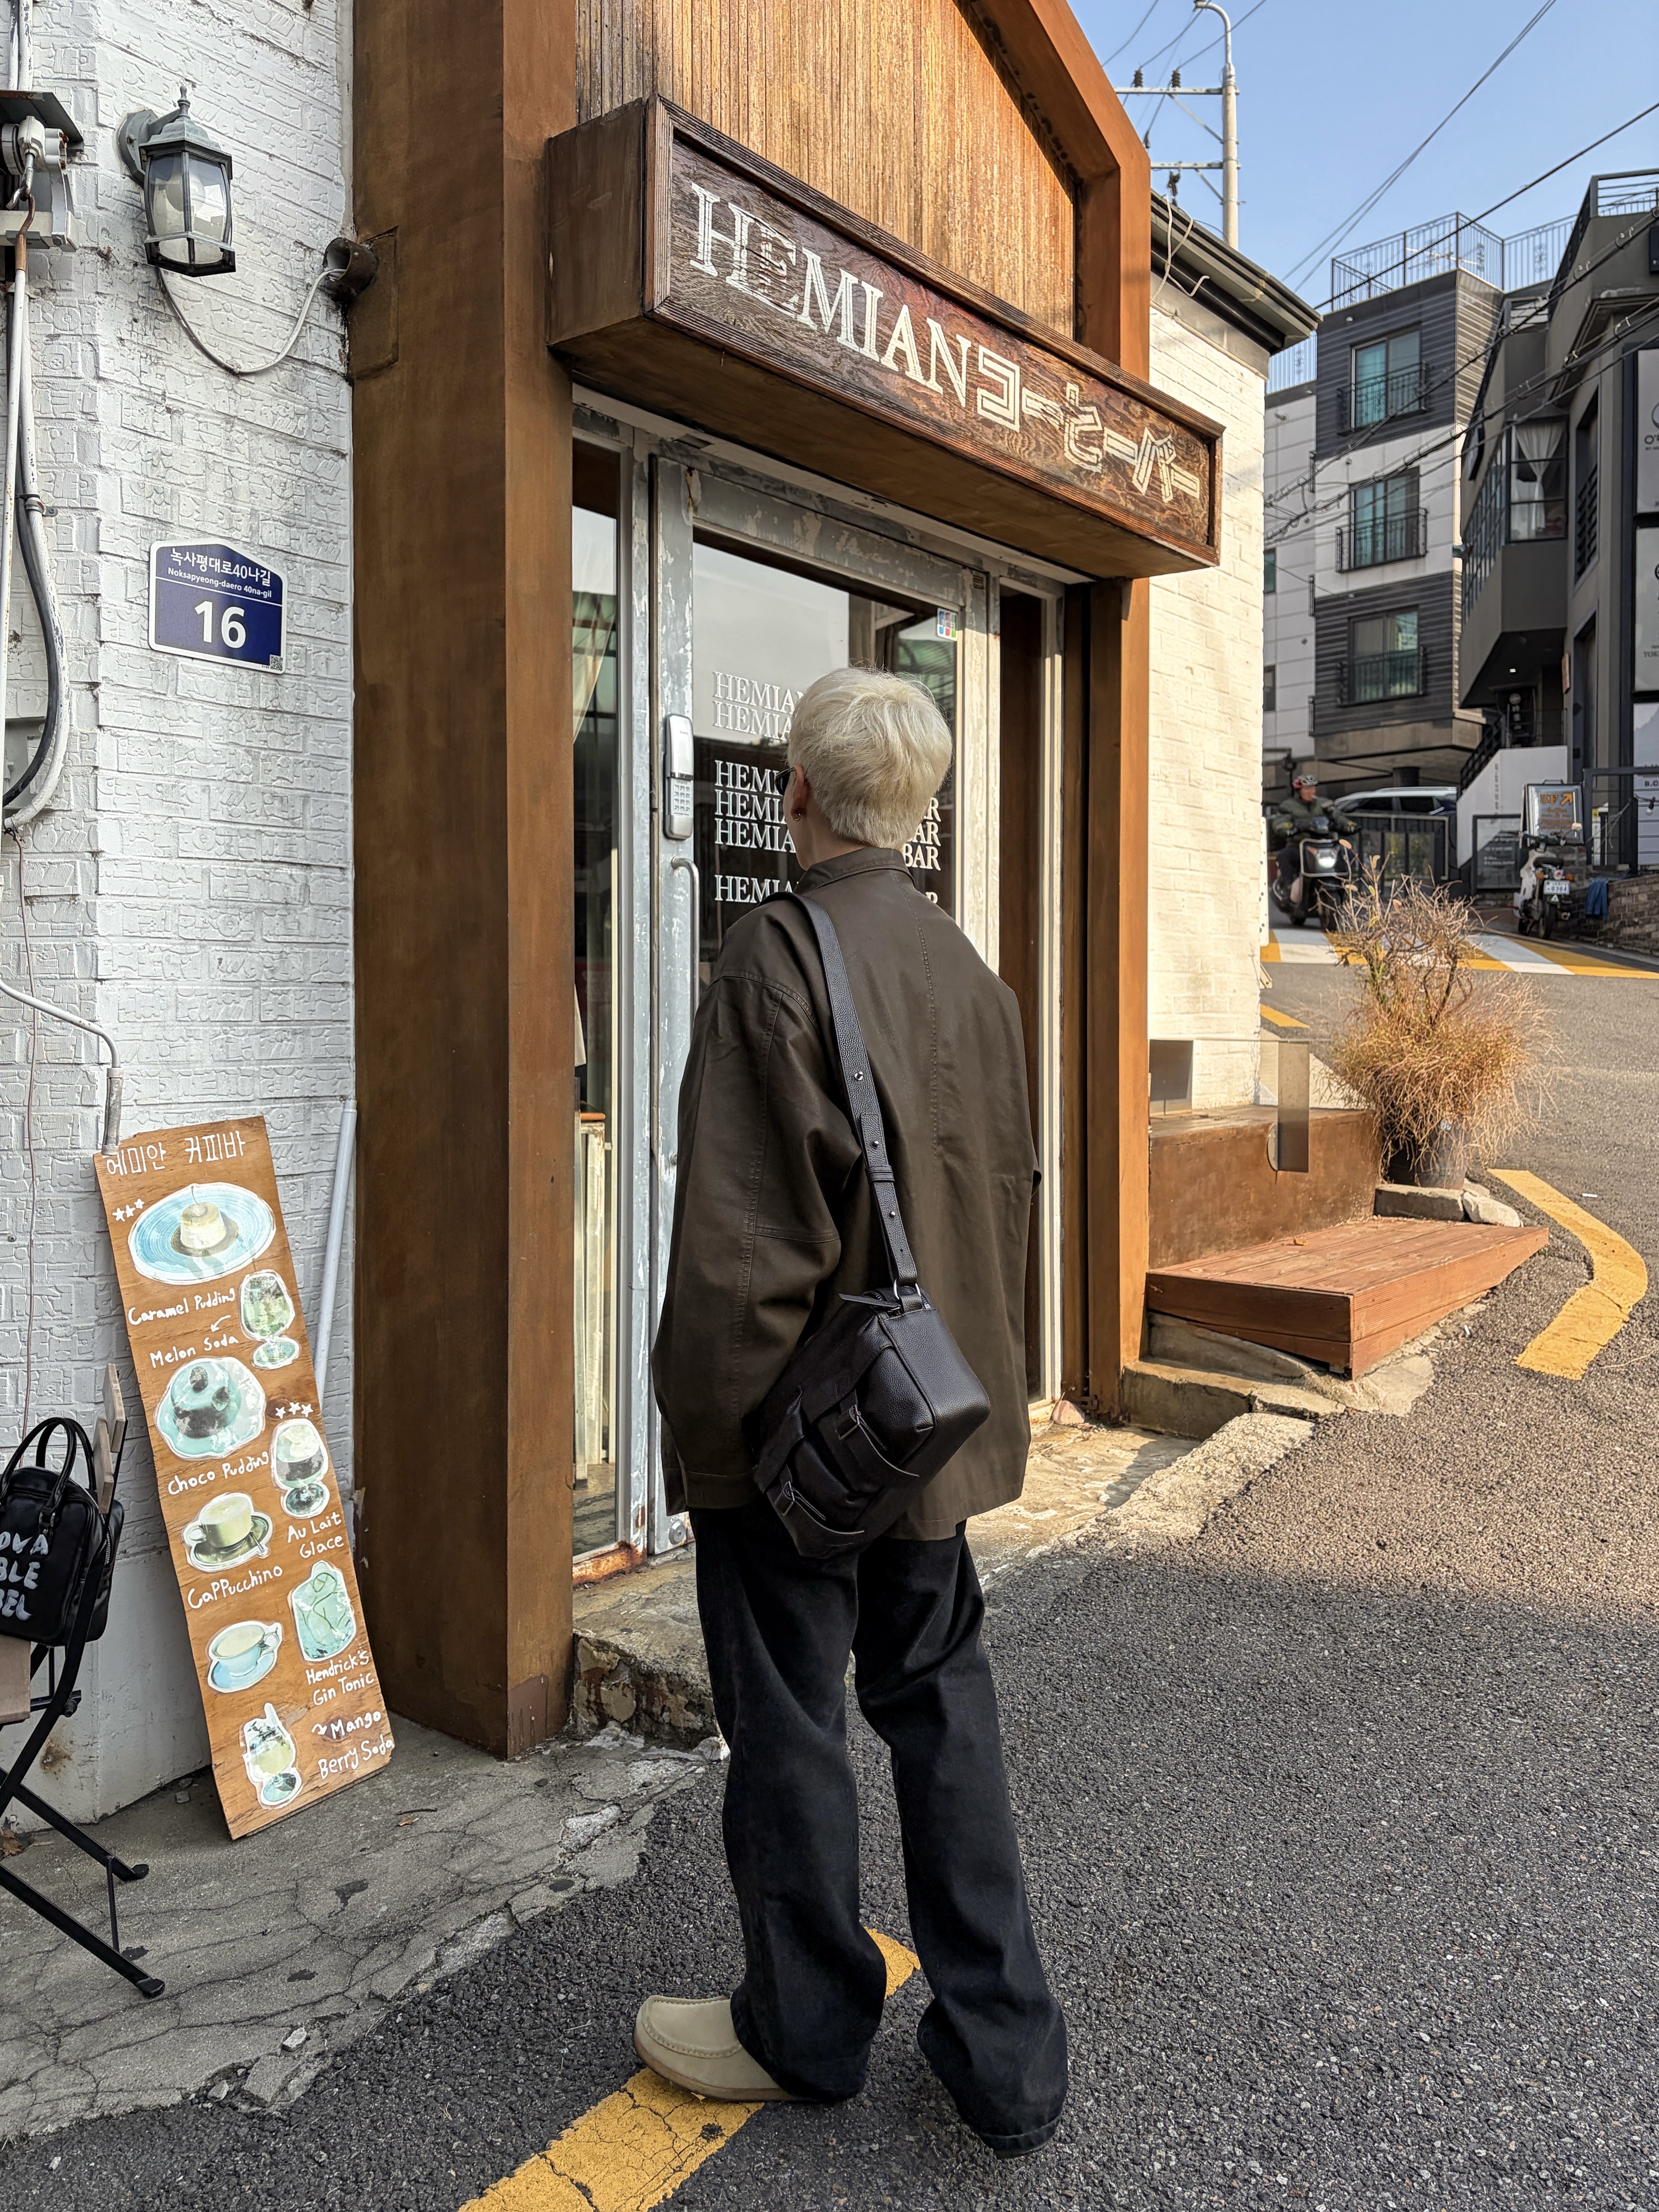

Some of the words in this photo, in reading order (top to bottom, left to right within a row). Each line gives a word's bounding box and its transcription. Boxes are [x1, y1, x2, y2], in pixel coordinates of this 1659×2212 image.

[168, 567, 242, 591] Noksapyeong-daero
[244, 586, 272, 598] 40na-gil
[170, 548, 271, 587] 녹사평대로40나길
[195, 601, 246, 648] 16
[712, 671, 804, 715] HEMIA
[712, 700, 791, 740] HEMIA
[714, 789, 787, 824] HEMI
[714, 818, 796, 853] HEMIA
[184, 1130, 246, 1164] 커피바
[128, 1297, 189, 1325] Caramel
[194, 1288, 235, 1310] Pudding
[150, 1346, 196, 1368] Melon
[204, 1334, 239, 1351] Soda
[222, 1451, 269, 1479] Pudding
[288, 1525, 306, 1543] Au
[310, 1512, 342, 1534] Lait
[300, 1536, 344, 1558] Glace
[313, 1688, 336, 1705] Gin
[338, 1673, 375, 1694] Tonic
[331, 1711, 381, 1739] Mango
[318, 1747, 359, 1779] Berry
[361, 1734, 395, 1761] Soda
